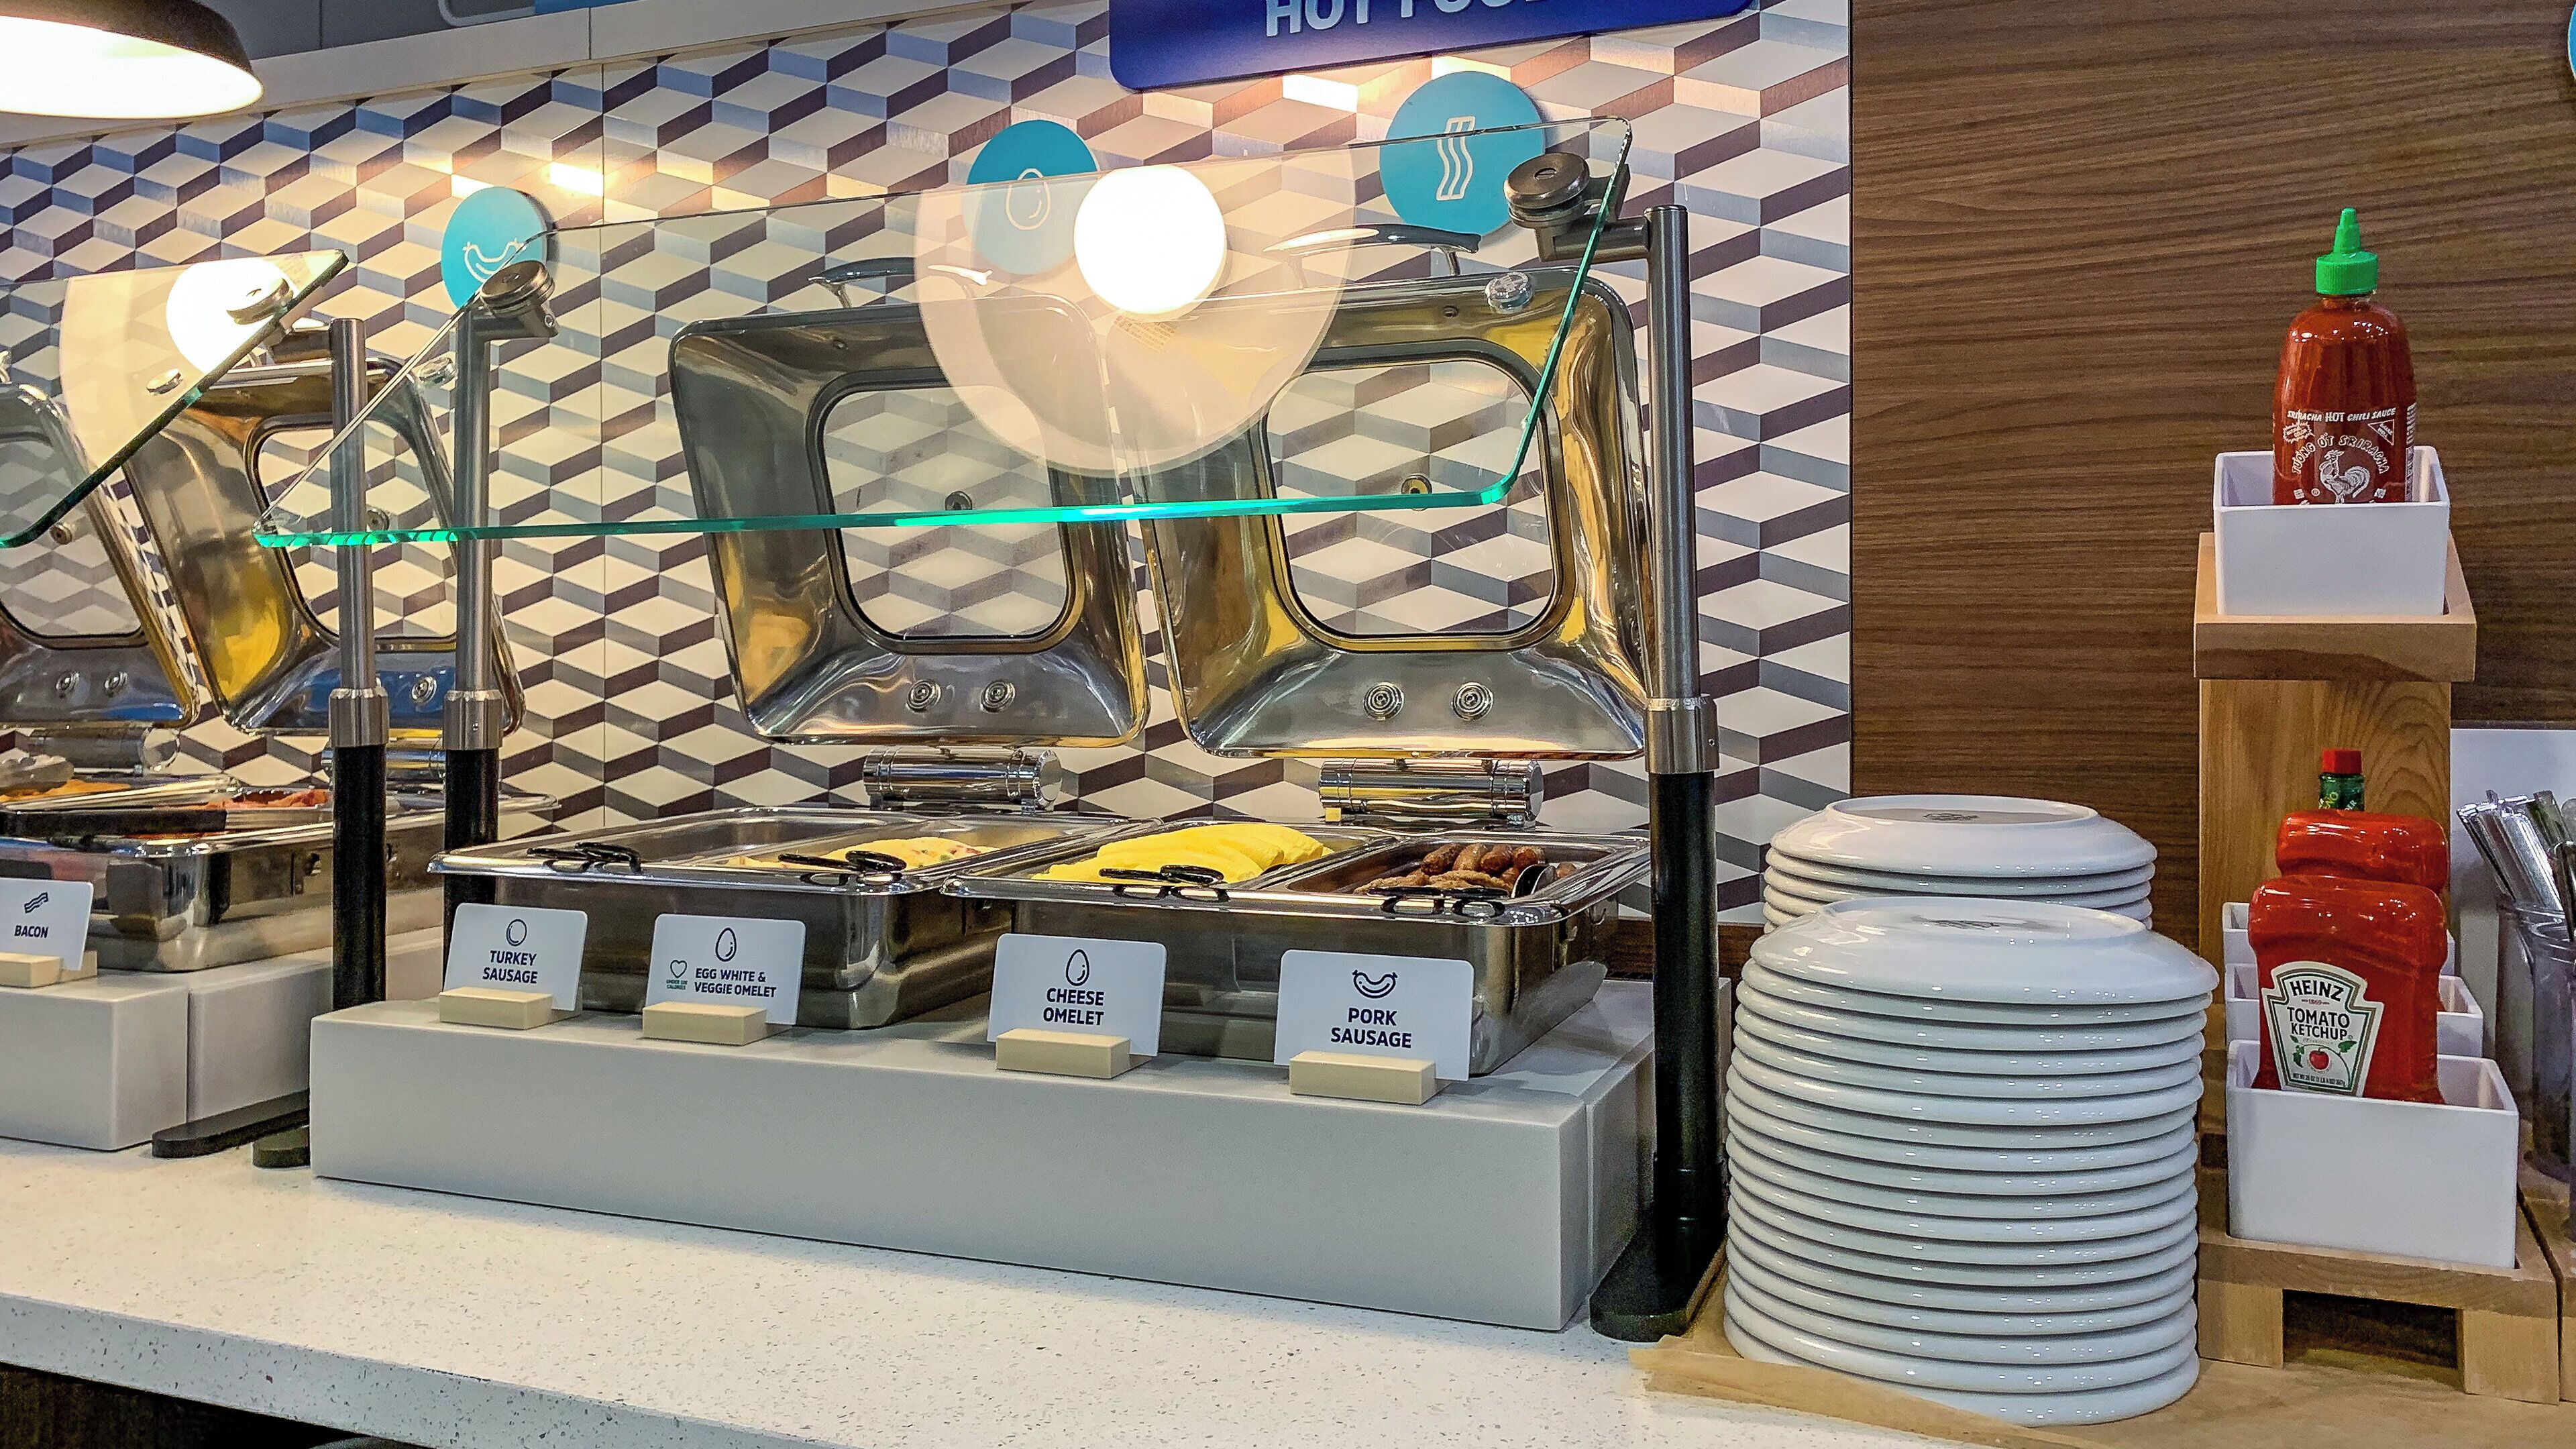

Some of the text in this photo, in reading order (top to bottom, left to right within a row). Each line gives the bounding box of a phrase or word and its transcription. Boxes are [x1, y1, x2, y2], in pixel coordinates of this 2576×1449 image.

[2287, 407, 2396, 422] SRIRACHA HOT CHILI SAUCE
[2339, 435, 2390, 474] SRIRACHA
[14, 925, 49, 938] BACON
[490, 950, 537, 966] TURKEY
[482, 967, 538, 983] SAUSAGE
[696, 968, 766, 983] EGG WHITE &
[694, 981, 733, 994] VEGGIE
[735, 984, 777, 998] OMELET
[1046, 987, 1105, 1006] CHEESE
[2290, 979, 2344, 1002] HEINZ
[1043, 1007, 1105, 1026] OMELET
[1348, 1007, 1397, 1026] PORK
[2286, 1006, 2350, 1028] TOMATO
[1330, 1027, 1412, 1049] SAUSAGE
[2291, 1022, 2348, 1040] KETCHUP
